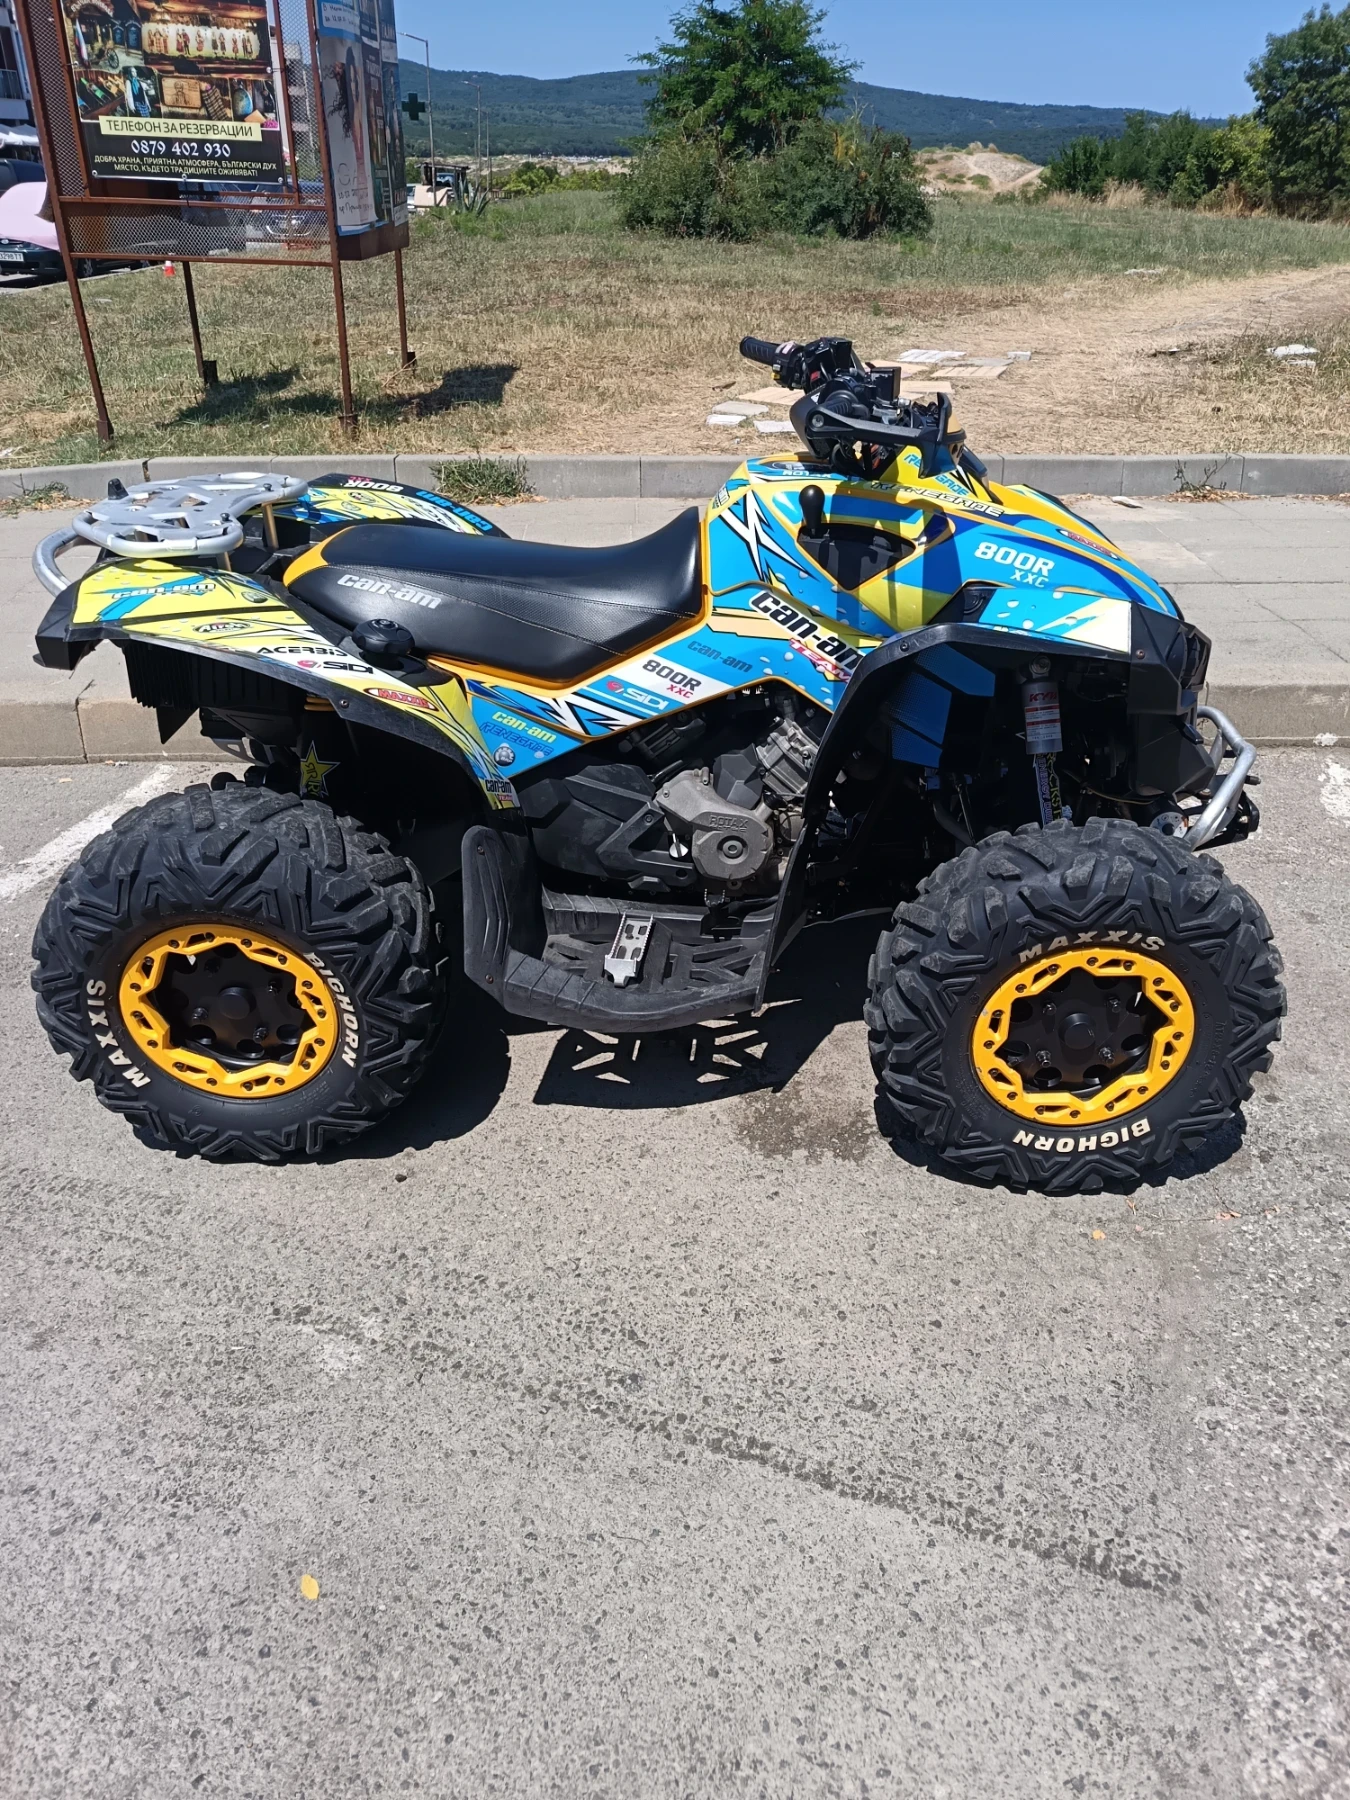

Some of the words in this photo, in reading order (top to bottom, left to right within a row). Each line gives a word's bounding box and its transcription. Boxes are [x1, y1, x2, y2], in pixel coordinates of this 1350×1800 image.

[106, 119, 162, 133] ТЕЛЕФОН
[162, 121, 178, 134] ЗА
[179, 123, 253, 138] РЕЗЕРВАЦИИ
[94, 155, 117, 163] ДОБРА
[117, 156, 143, 164] ХРАНА,
[143, 158, 177, 166] ПРИЯТНА
[177, 158, 221, 168] АТМОСФЕРА,
[221, 160, 262, 170] БЪЛГАРСКИ
[262, 162, 277, 170] ДУХ
[131, 139, 166, 155] 0879
[171, 141, 199, 156] 402
[204, 143, 231, 158] 930
[114, 163, 141, 173] МЯСТО,
[141, 165, 170, 174] КЪДЕТО
[170, 166, 217, 176] ТРАДИЦИИТЕ
[217, 168, 258, 177] ОЖИВЯВАТ!
[343, 479, 404, 493] 800R
[869, 481, 1005, 518] RENEGADE
[415, 489, 494, 532] can-am
[974, 541, 1055, 578] 800R
[111, 582, 216, 599] can-am
[336, 573, 442, 609] can-am
[1010, 569, 1049, 588] XXC
[257, 646, 349, 657] ACERBIS
[687, 640, 753, 673] can-am
[642, 658, 702, 691] 800R
[377, 688, 429, 709] MAXXIS
[621, 687, 670, 710] SIDI
[666, 684, 695, 699] XXC
[479, 721, 555, 758] RENEGADE
[491, 710, 557, 744] can-am
[708, 814, 749, 832] ROTAX
[1018, 929, 1166, 964] MAXXIS
[302, 951, 360, 1069] BIGHORN
[85, 978, 152, 1088] MAXXIS
[1011, 1116, 1152, 1153] BIGHORN
